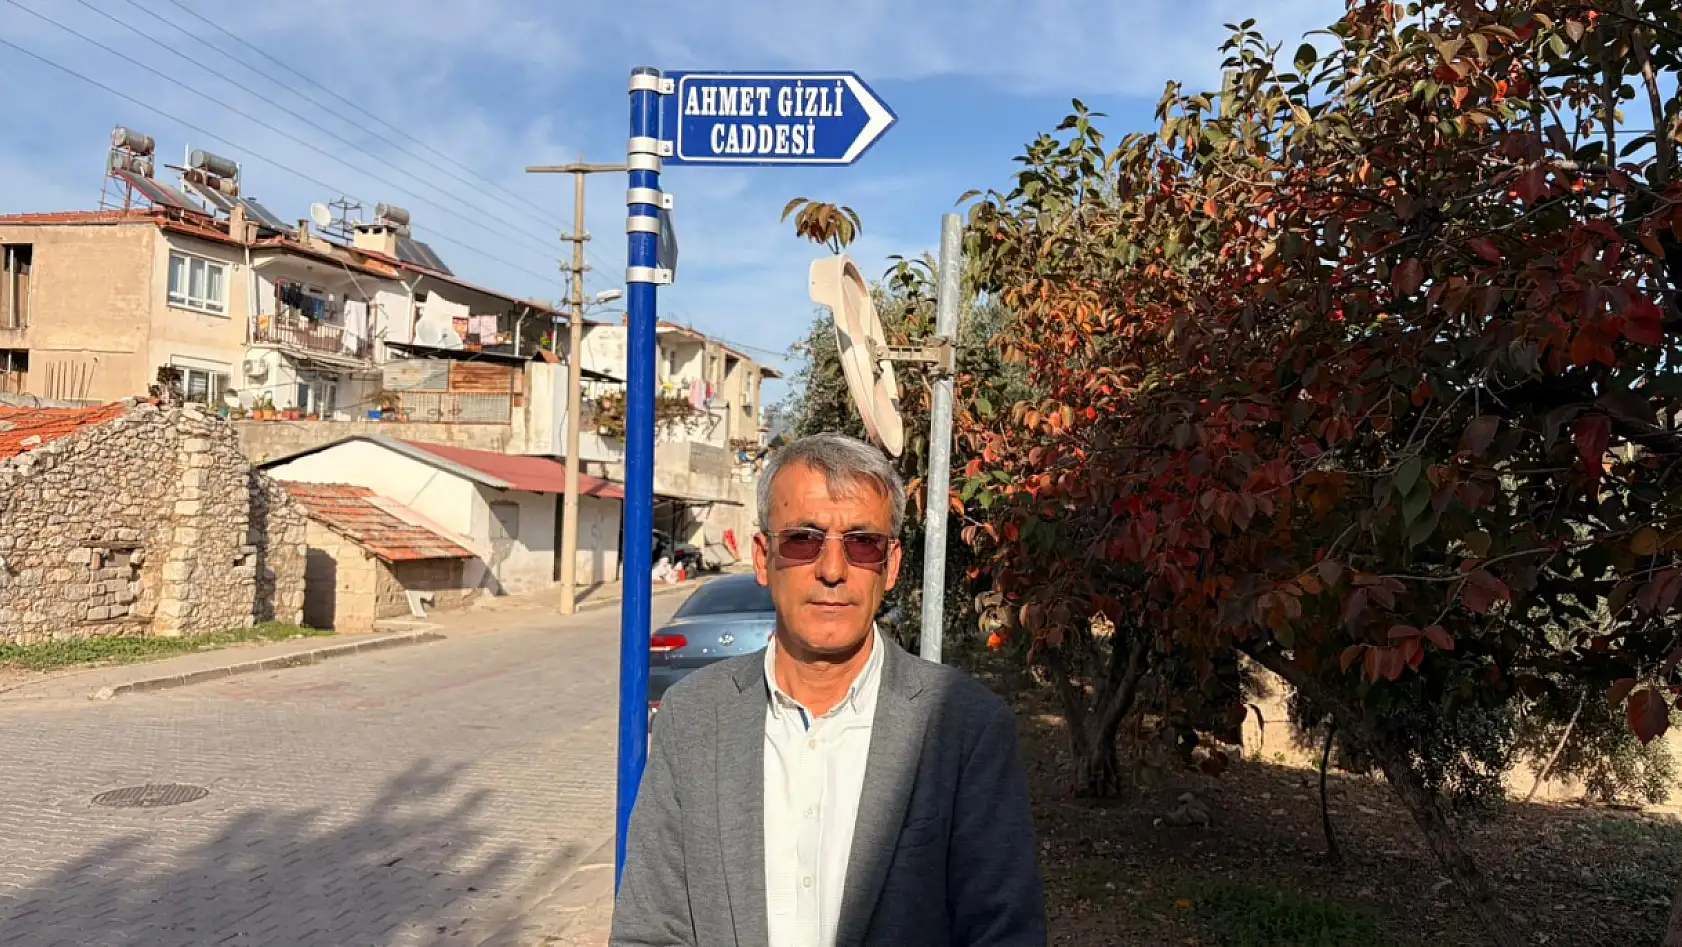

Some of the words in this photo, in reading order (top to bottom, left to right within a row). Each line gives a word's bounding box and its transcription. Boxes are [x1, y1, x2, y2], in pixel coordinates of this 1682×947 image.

[685, 86, 771, 116] AHMET
[777, 80, 844, 116] GİZLİ
[710, 119, 816, 154] CADDESİ
